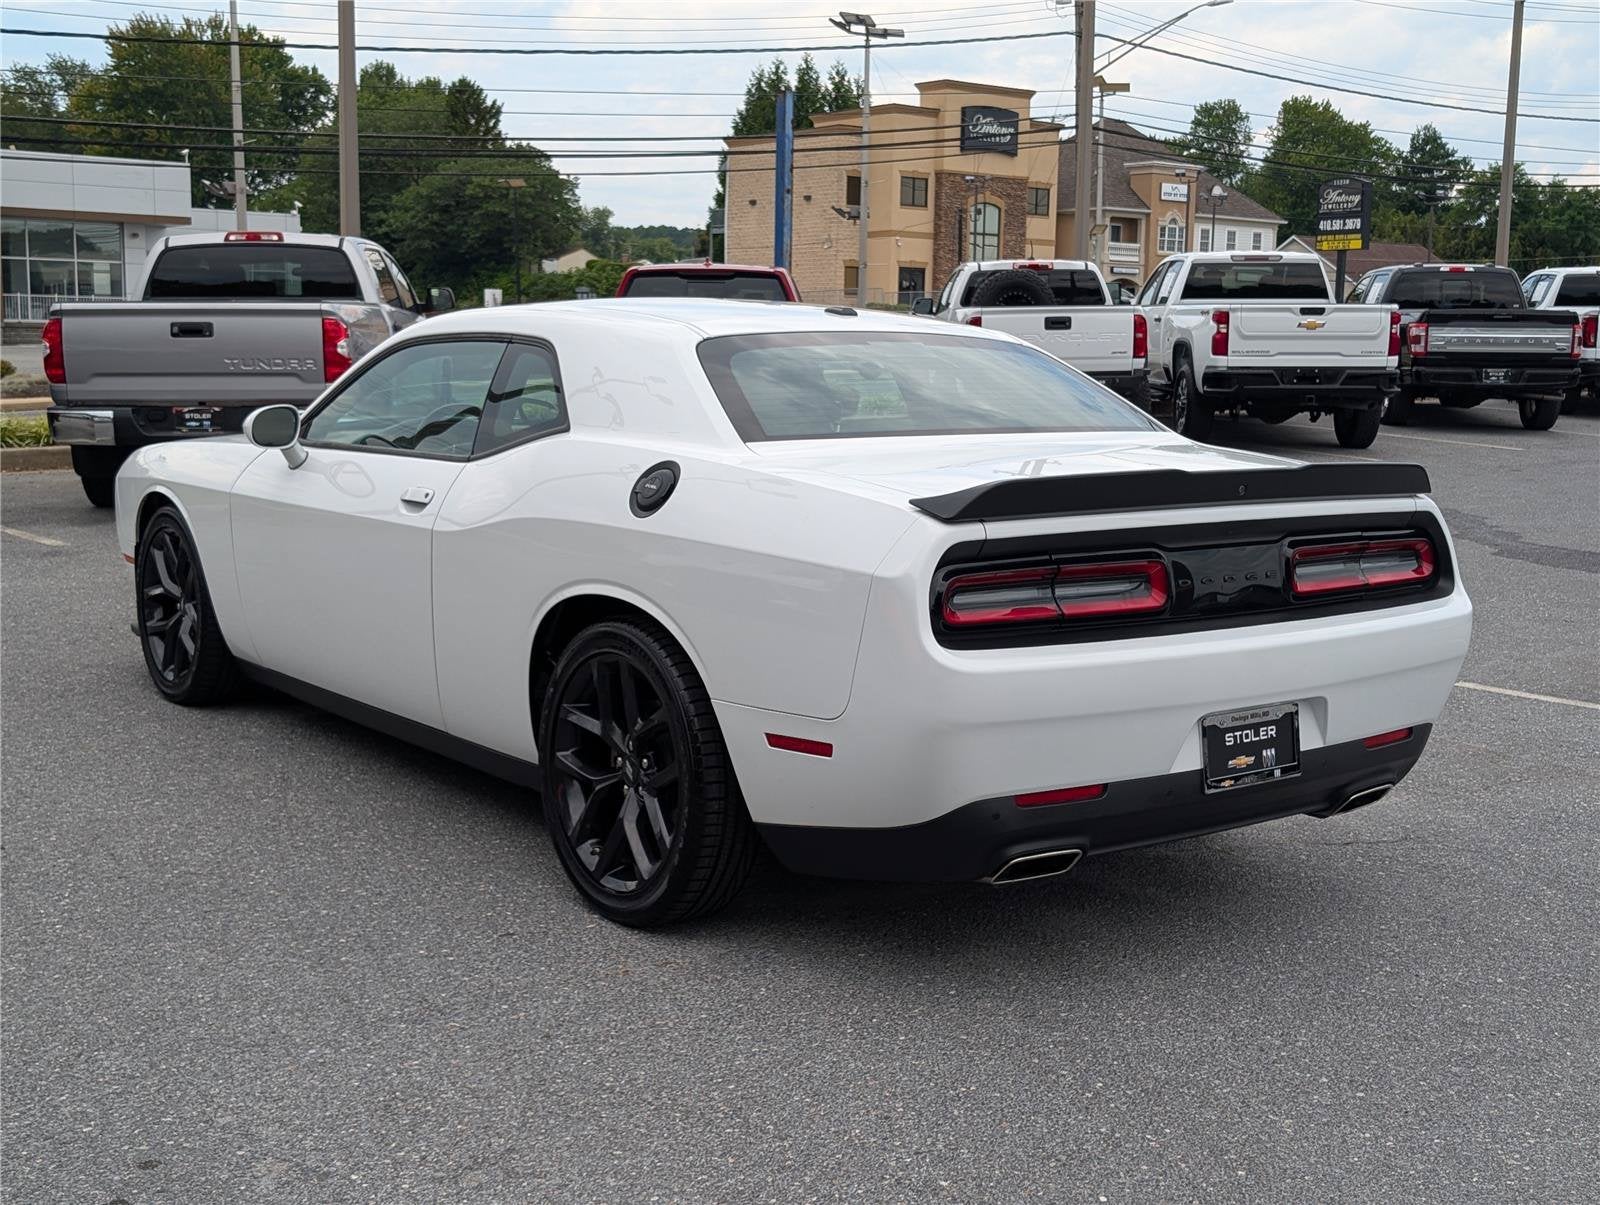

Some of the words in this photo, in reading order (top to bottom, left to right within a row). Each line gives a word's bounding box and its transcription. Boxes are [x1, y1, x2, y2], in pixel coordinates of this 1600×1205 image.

[1319, 189, 1362, 207] Antony
[224, 358, 317, 370] TUNDRA
[185, 412, 212, 420] STOLER
[1225, 725, 1277, 746] STOLER
